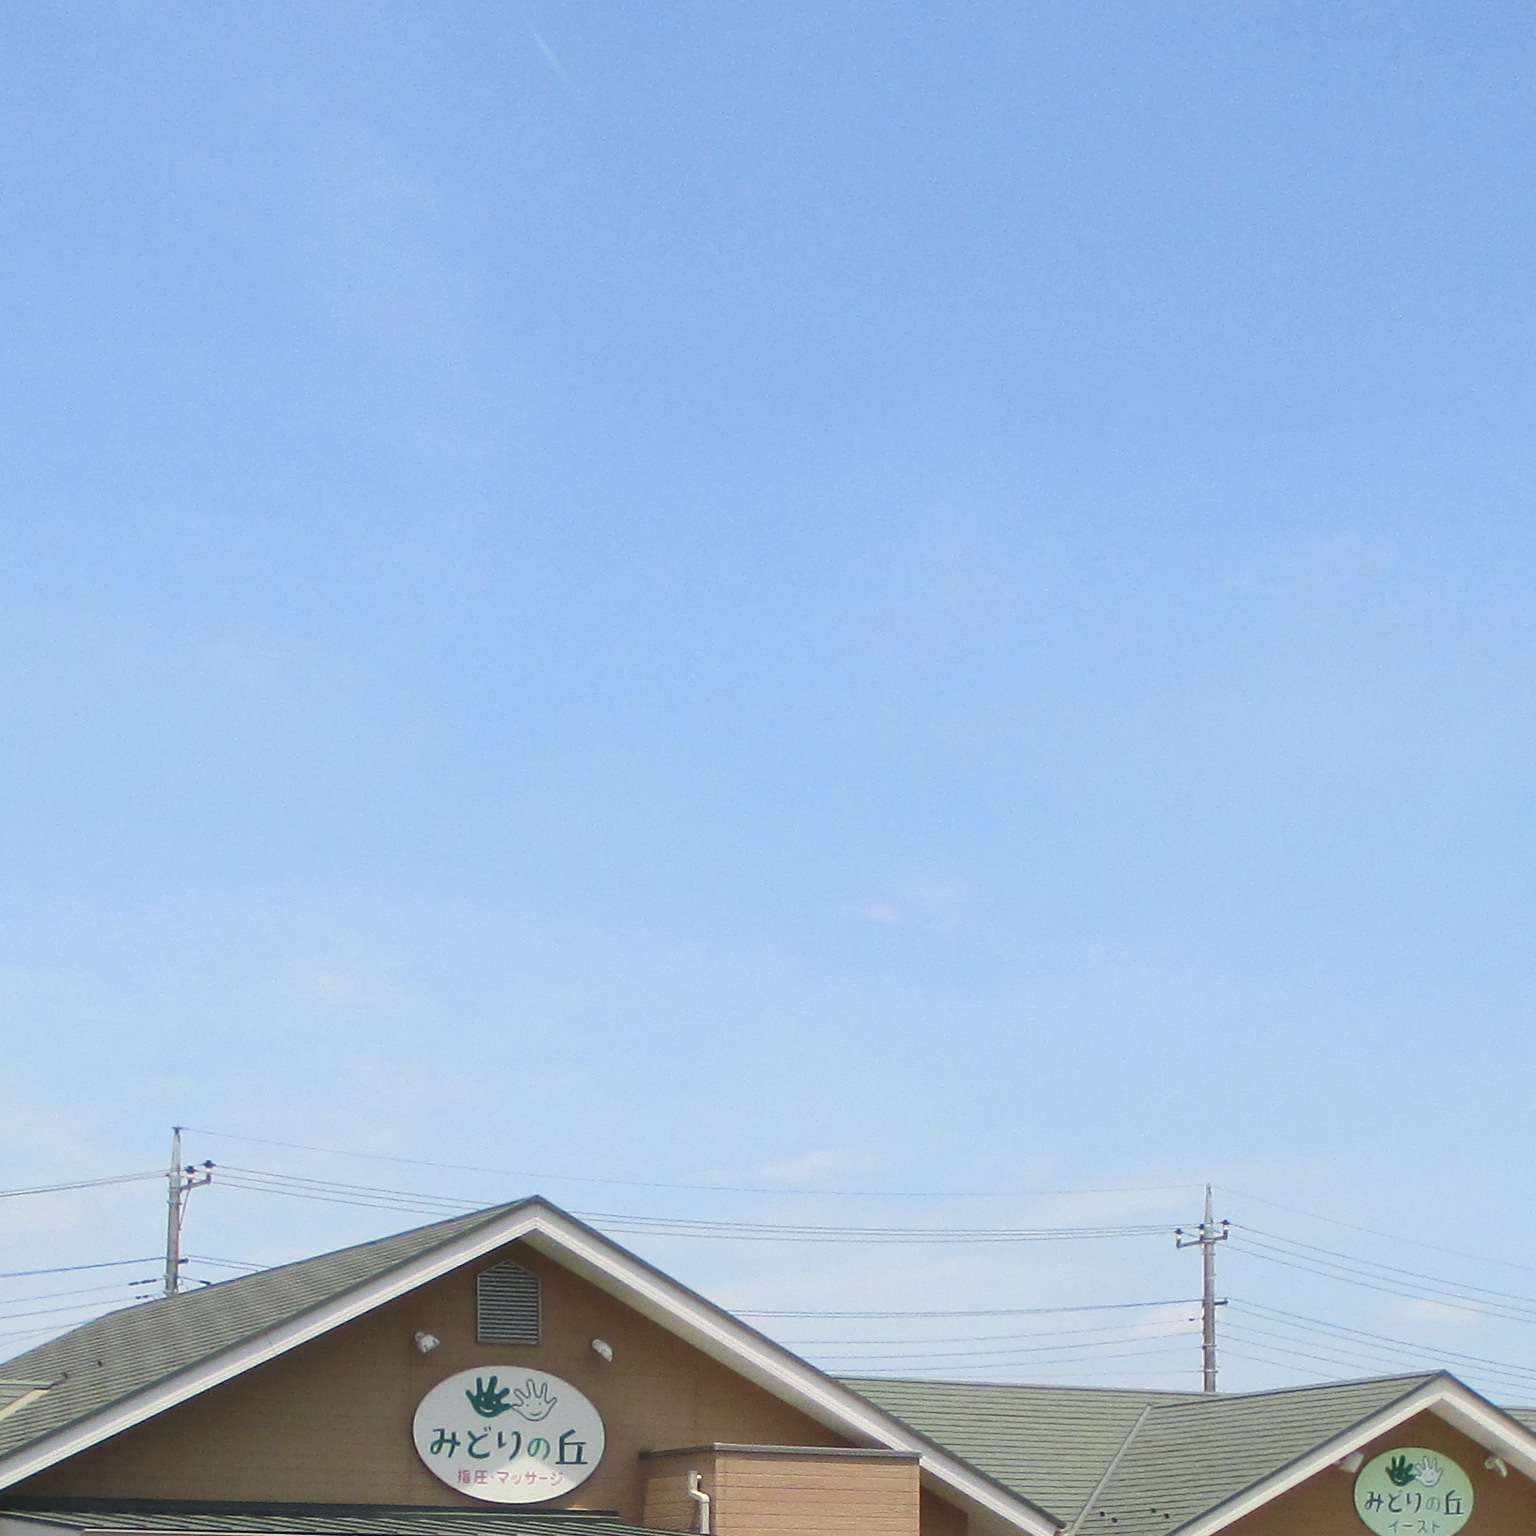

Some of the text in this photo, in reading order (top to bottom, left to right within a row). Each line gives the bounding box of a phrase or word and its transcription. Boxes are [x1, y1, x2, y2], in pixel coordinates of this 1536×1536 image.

[429, 1426, 588, 1465] みどりの丘
[1364, 1489, 1465, 1516] みどりの丘
[1387, 1519, 1441, 1534] イースト
